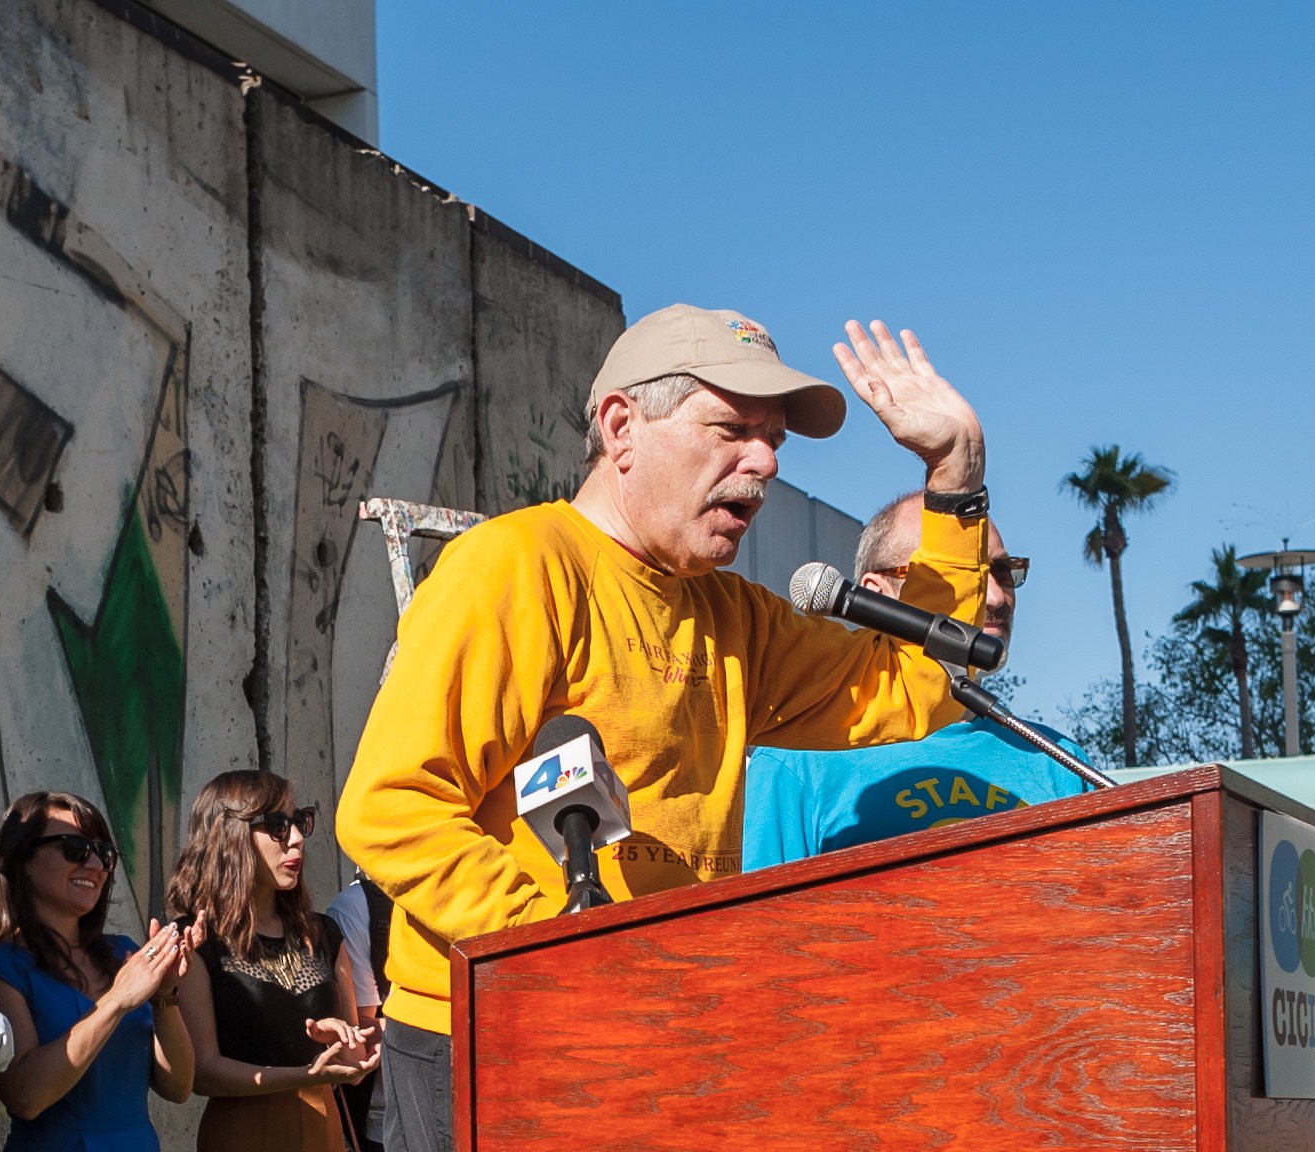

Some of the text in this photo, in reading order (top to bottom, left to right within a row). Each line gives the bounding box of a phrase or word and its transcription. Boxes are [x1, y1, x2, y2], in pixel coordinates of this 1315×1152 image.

[520, 753, 562, 799] 4
[611, 845, 741, 873] 25 YEAR REUN
